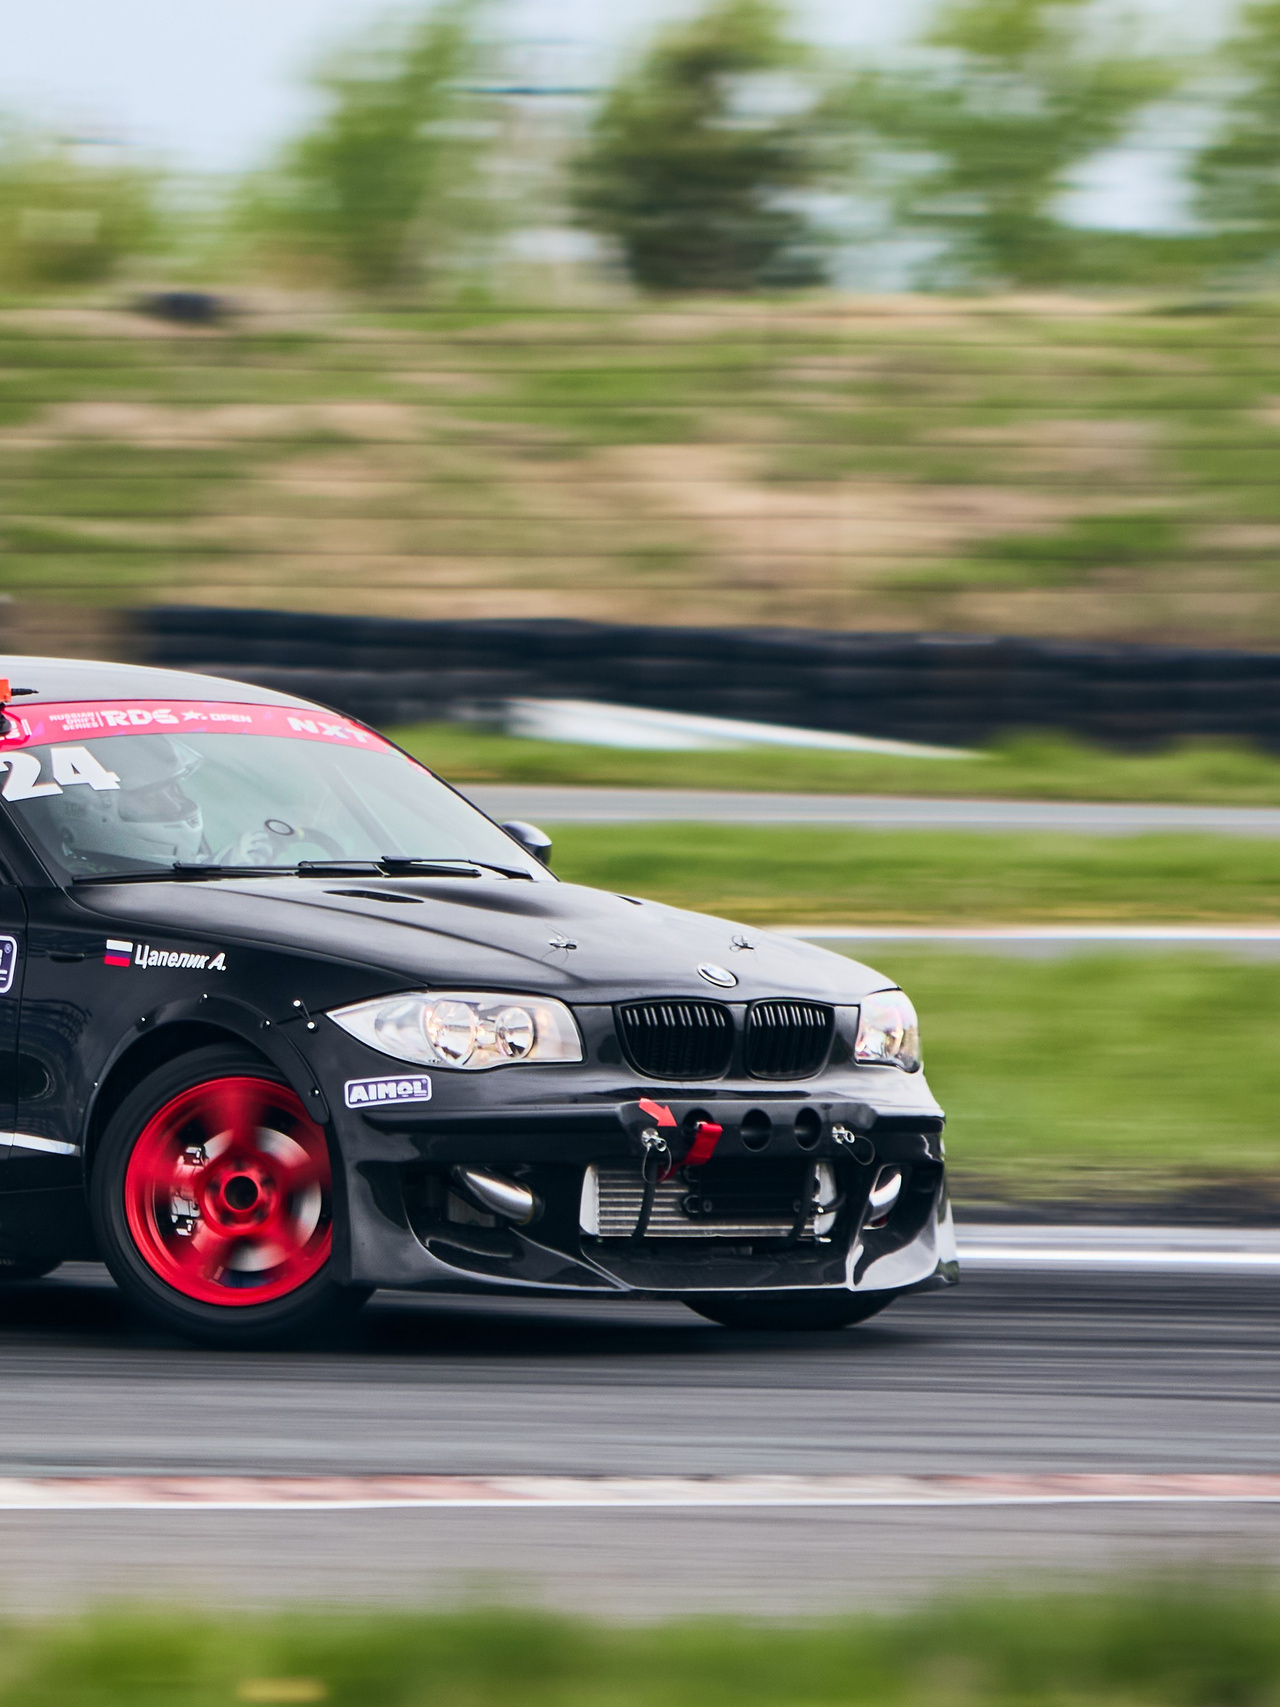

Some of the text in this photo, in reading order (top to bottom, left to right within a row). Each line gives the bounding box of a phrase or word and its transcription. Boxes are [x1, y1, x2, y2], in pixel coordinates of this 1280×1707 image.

[49, 711, 95, 721] RUSSIAN
[66, 717, 96, 725] DRIFT
[100, 709, 252, 727] RDS OPEN
[62, 722, 99, 731] SERIES
[287, 717, 369, 743] NXT
[134, 944, 227, 971] Цапелик А.
[349, 1081, 427, 1103] AIMOL
